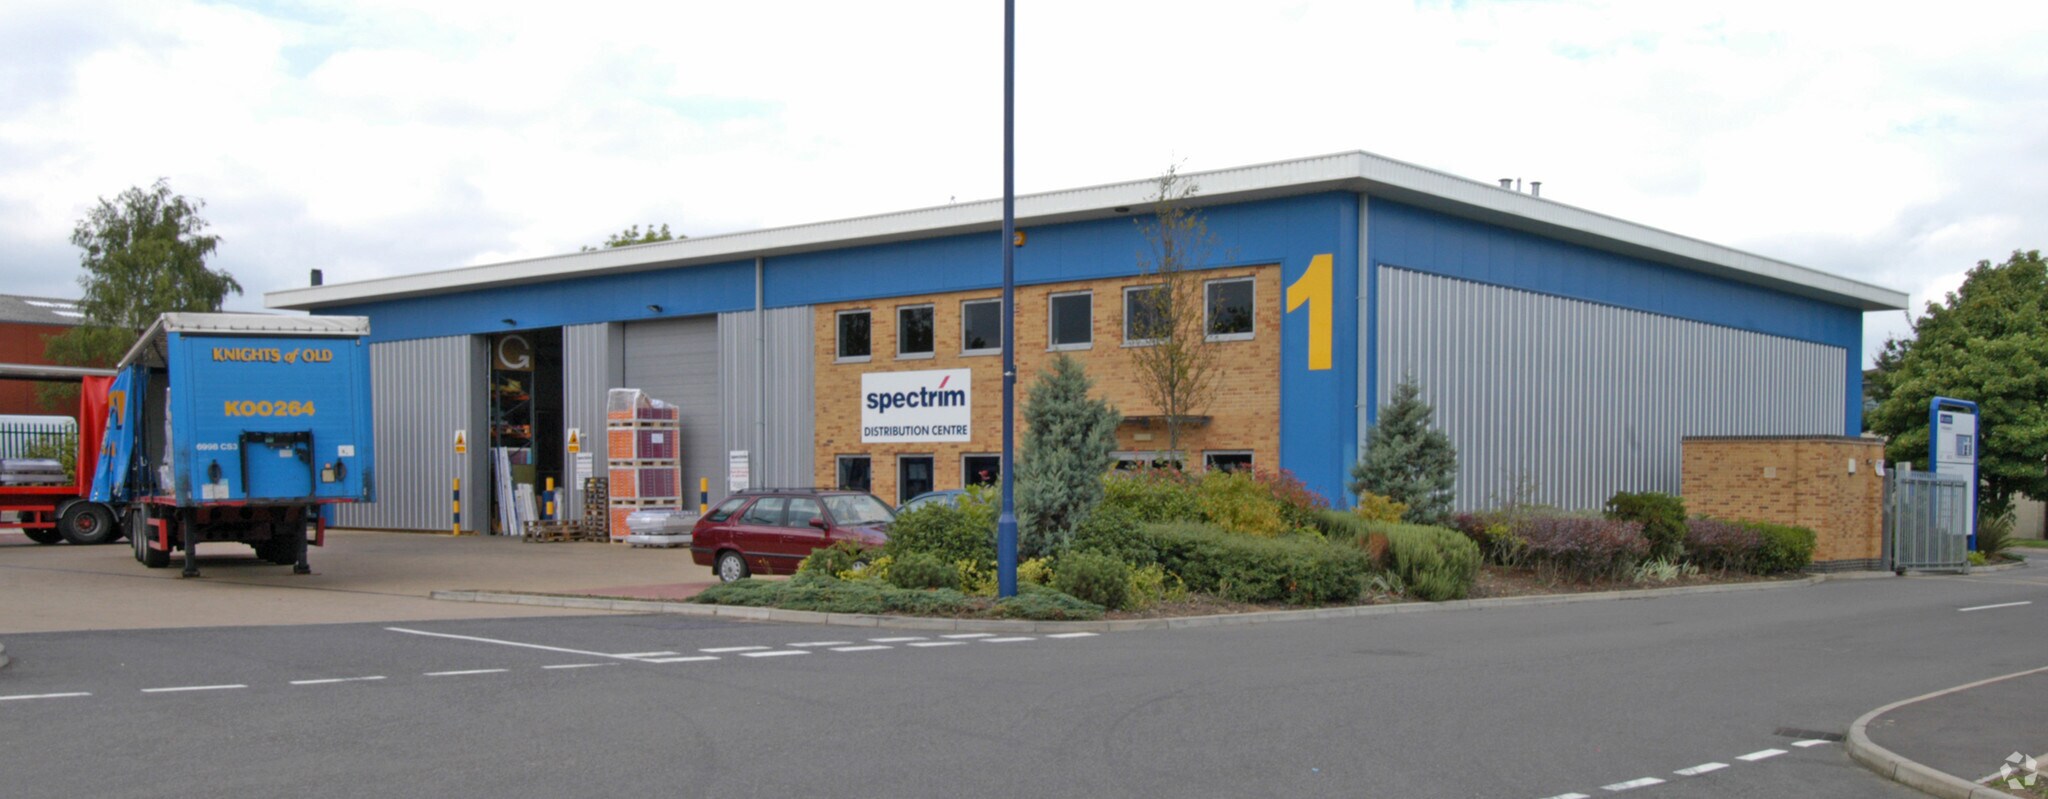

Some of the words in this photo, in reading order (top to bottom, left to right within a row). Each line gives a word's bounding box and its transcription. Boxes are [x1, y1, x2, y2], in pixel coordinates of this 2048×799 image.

[1286, 253, 1333, 371] 1
[212, 348, 281, 363] KNIGHTS
[284, 348, 300, 364] of
[301, 349, 333, 363] OLD
[864, 425, 930, 437] DISTRIBUTION
[931, 424, 968, 436] CENTRE
